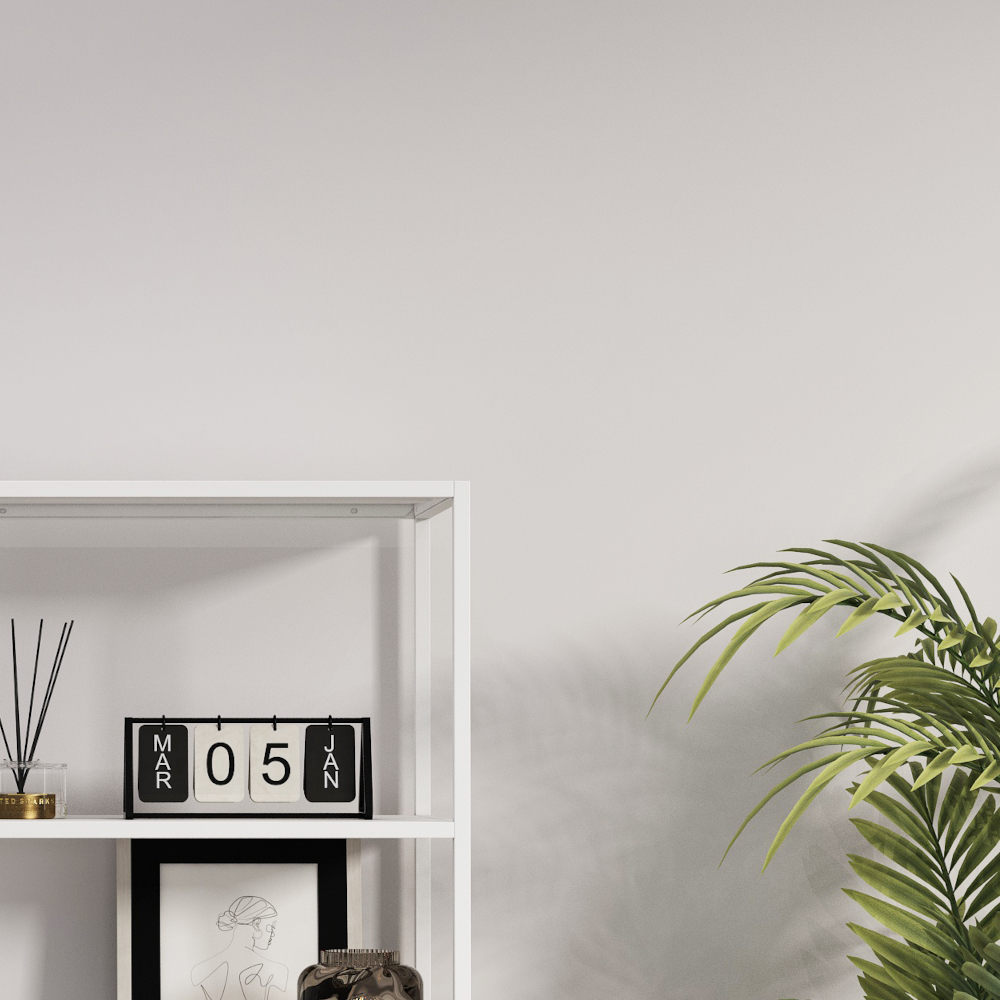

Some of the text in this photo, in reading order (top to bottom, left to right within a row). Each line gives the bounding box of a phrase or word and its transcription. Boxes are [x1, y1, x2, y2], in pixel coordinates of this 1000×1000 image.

[153, 734, 172, 789] MAR
[323, 734, 339, 789] JAN
[0, 797, 16, 805] TED
